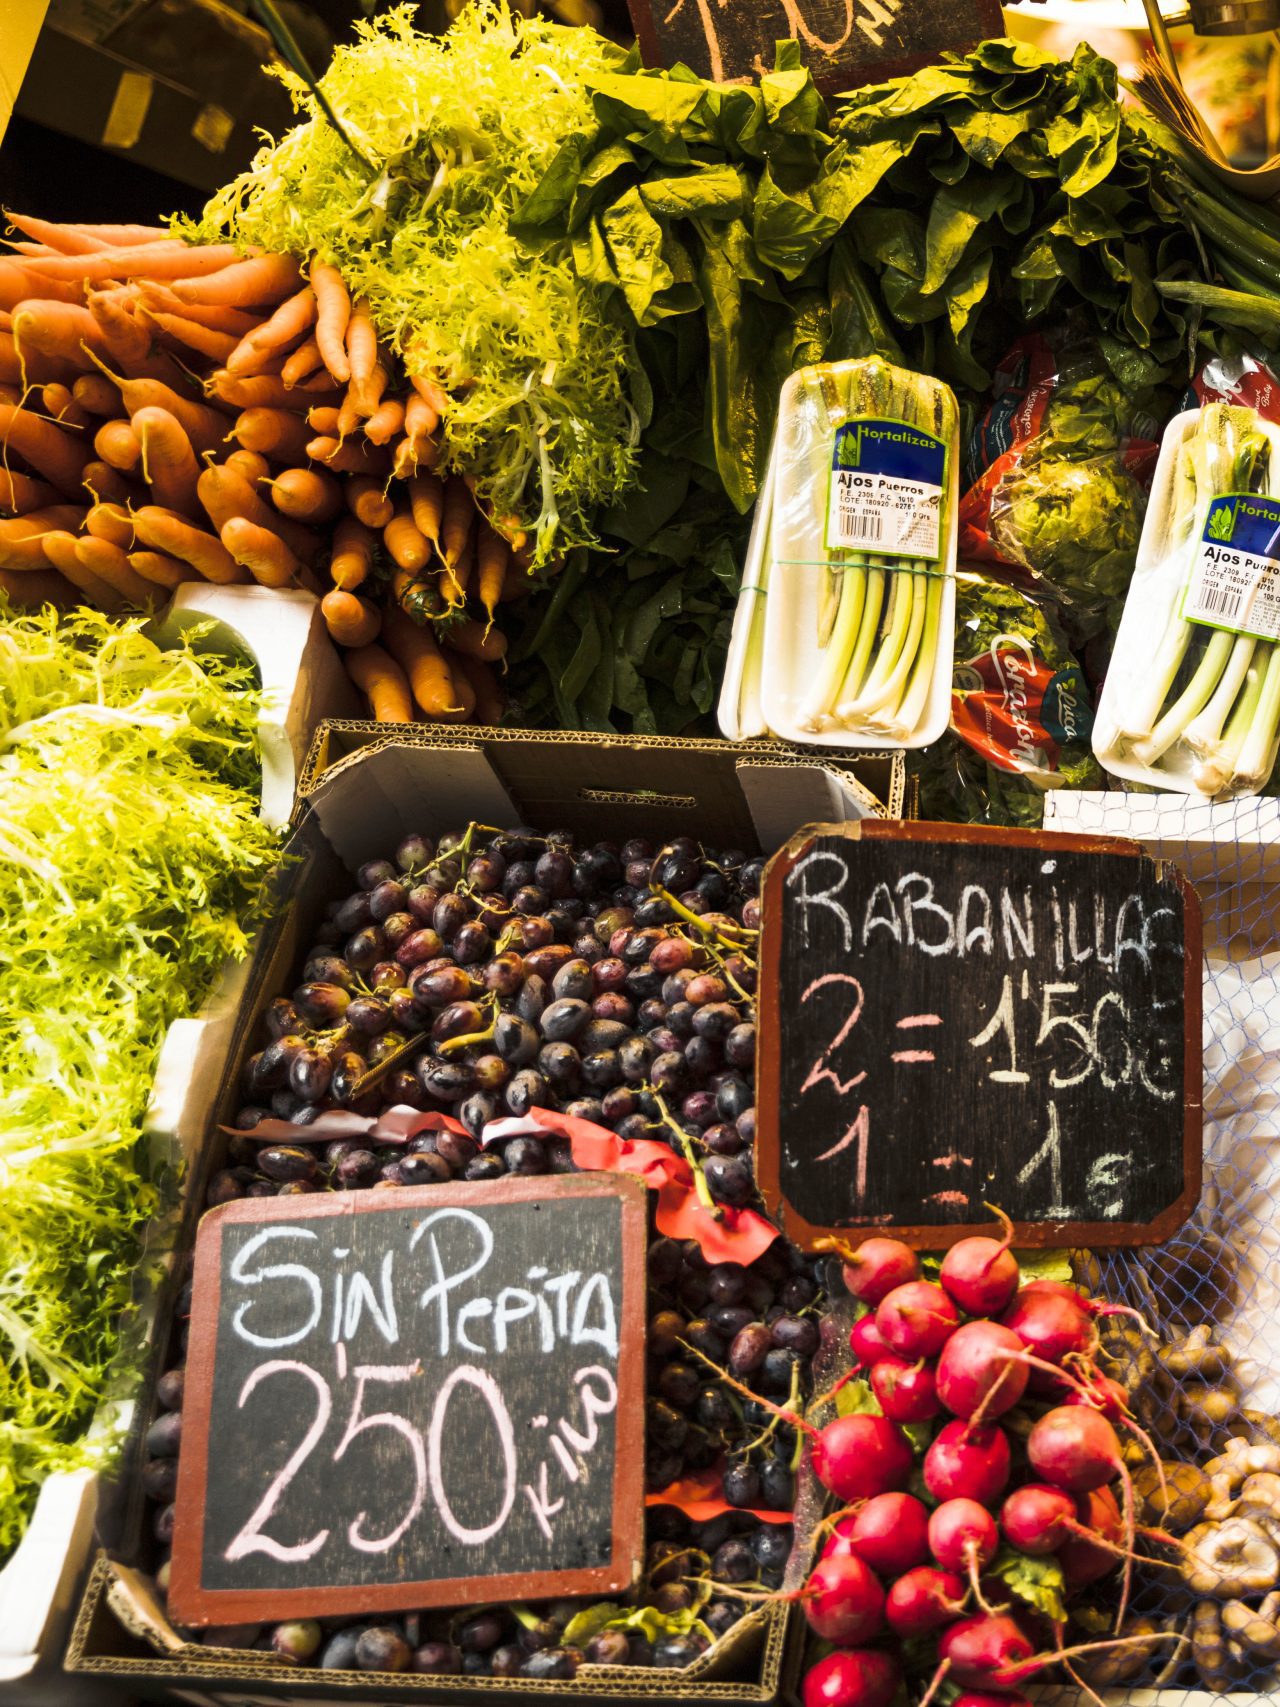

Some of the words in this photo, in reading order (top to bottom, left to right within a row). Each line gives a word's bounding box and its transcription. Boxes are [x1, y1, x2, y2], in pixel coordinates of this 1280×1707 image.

[860, 425, 937, 449] Hortalizas
[838, 473, 873, 488] Ajos
[878, 480, 924, 495] Puerros
[1204, 547, 1240, 565] Ajos
[1056, 683, 1078, 742] Luca
[800, 972, 868, 1094] 2
